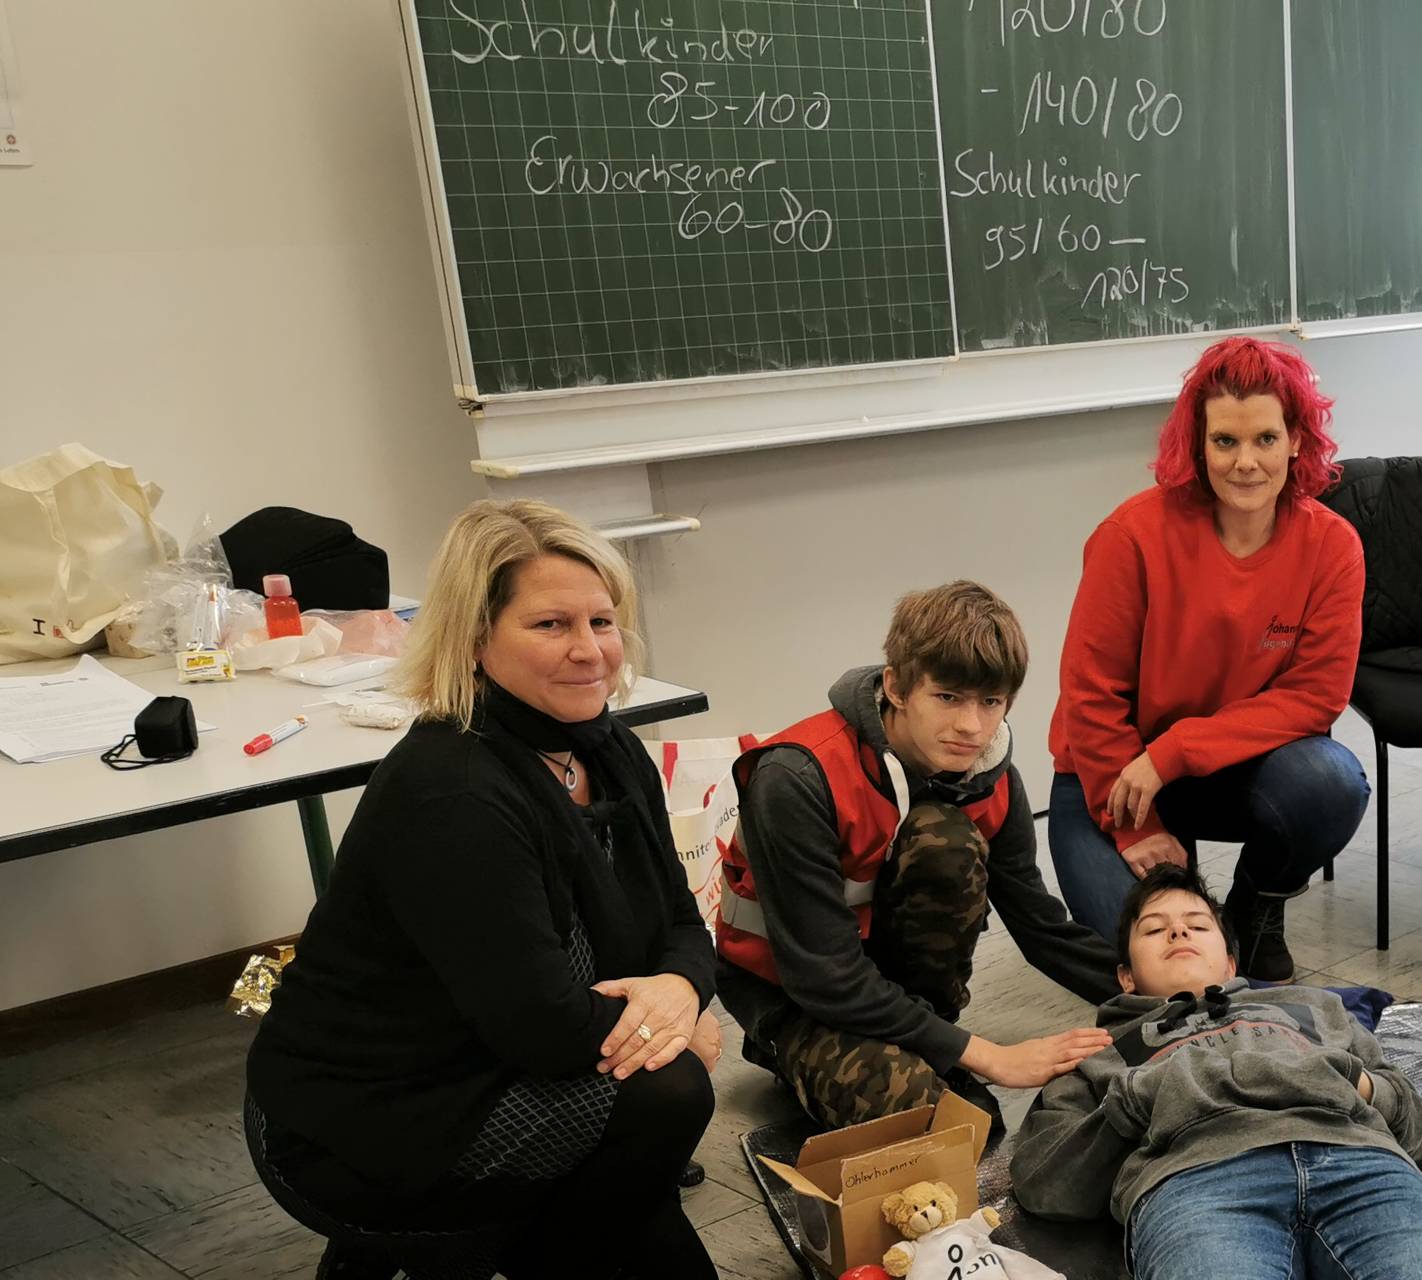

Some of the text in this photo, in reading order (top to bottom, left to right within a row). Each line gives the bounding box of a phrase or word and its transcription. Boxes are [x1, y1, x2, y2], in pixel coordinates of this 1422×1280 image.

[450, 0, 772, 64] Schulkinder
[647, 72, 831, 130] 85-100
[1018, 71, 1183, 142] 140/80
[524, 135, 777, 195] Erwachsener
[950, 148, 1142, 205] Schulkinder
